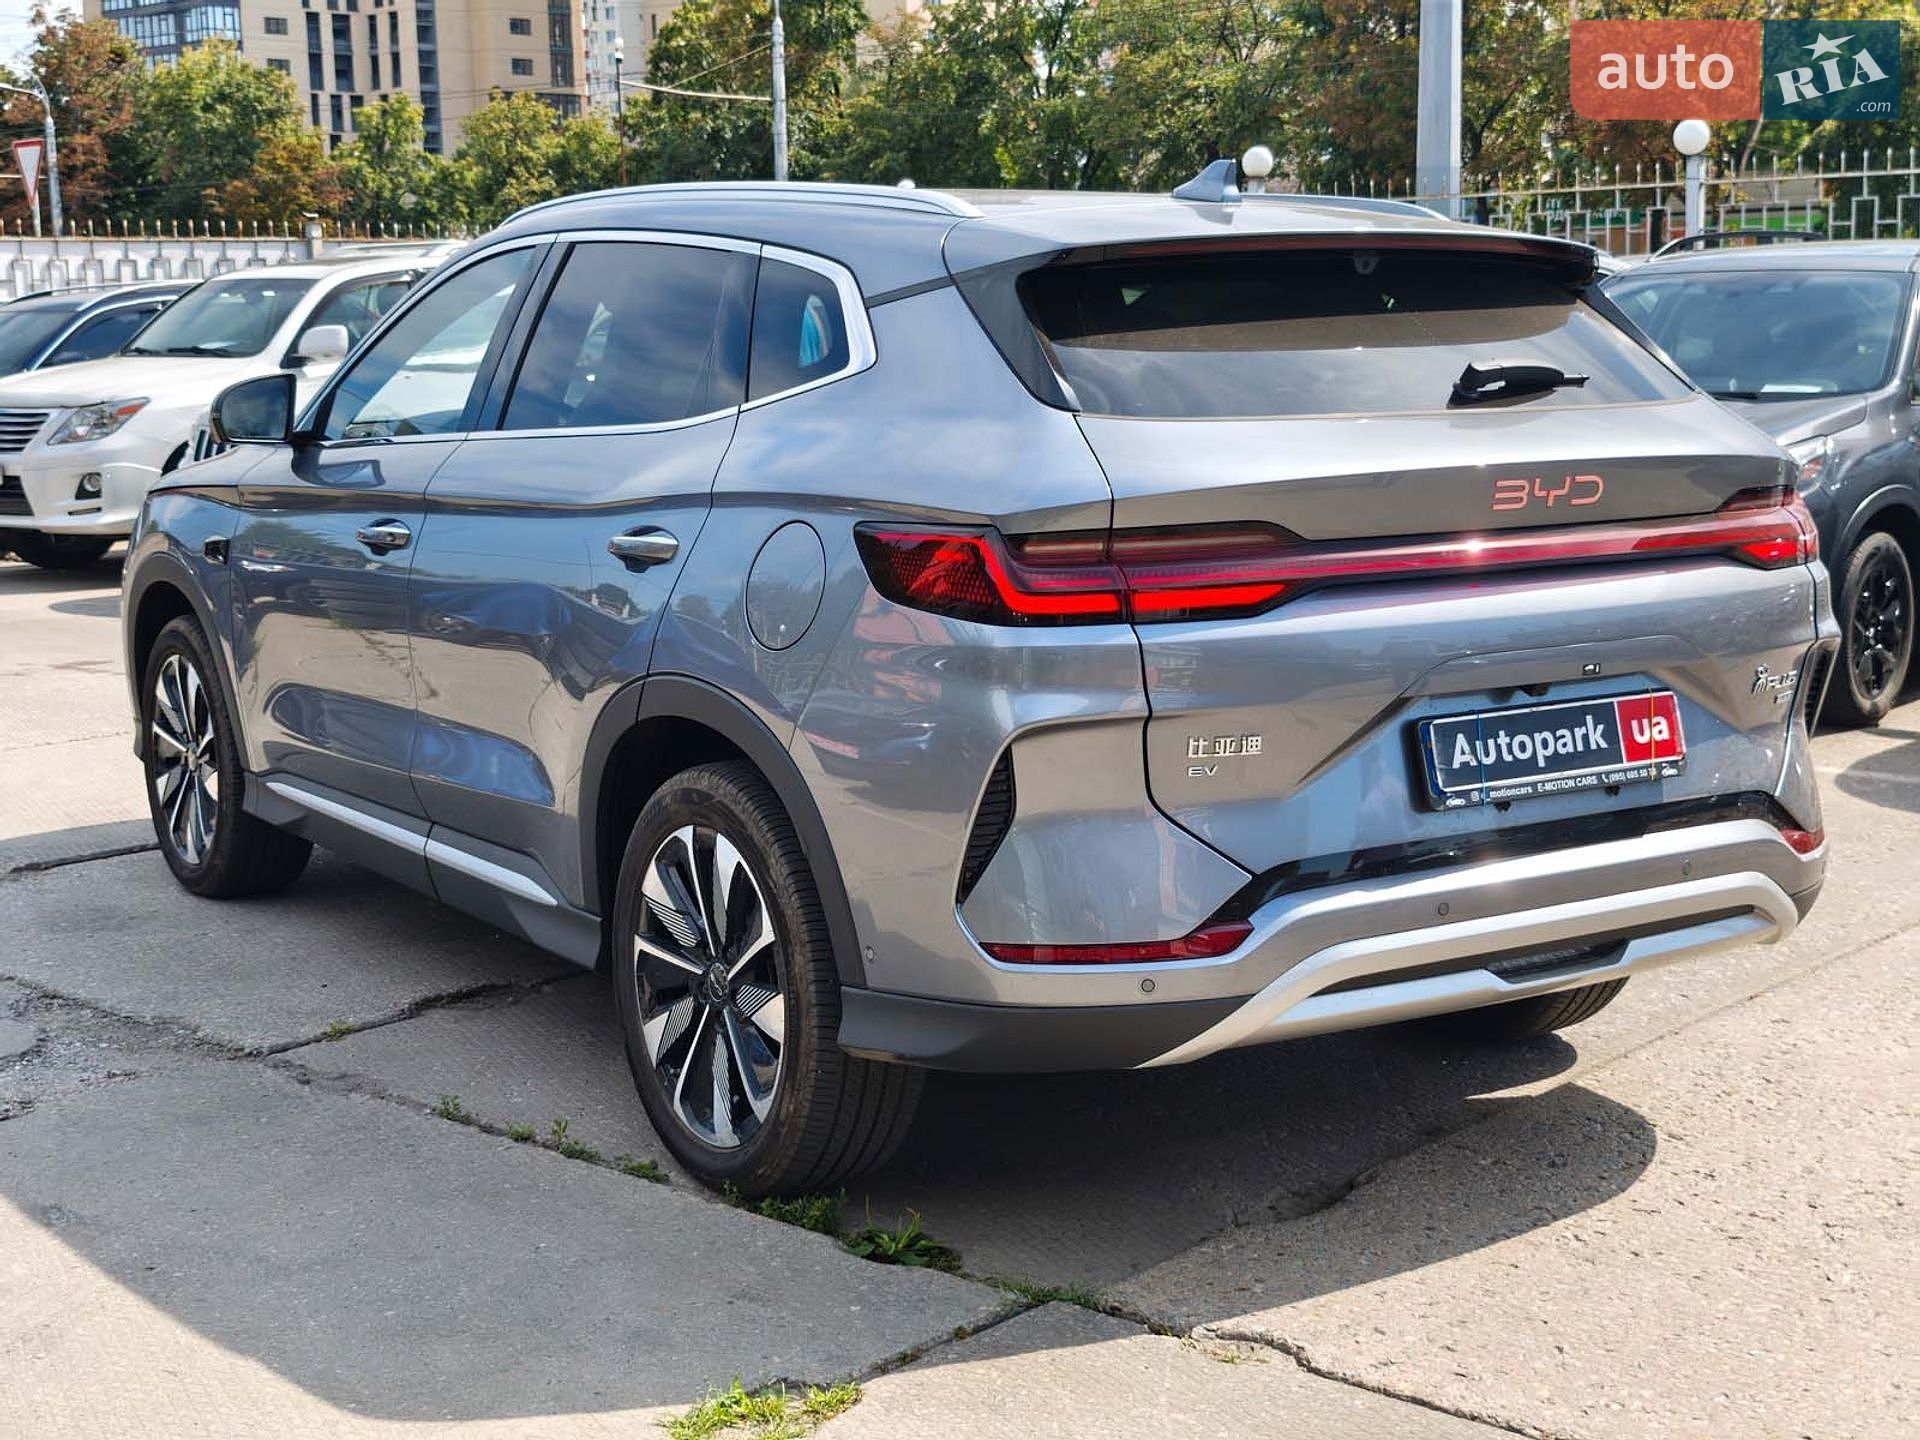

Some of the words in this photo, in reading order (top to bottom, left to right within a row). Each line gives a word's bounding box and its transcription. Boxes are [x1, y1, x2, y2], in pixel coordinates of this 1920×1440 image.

[1492, 475, 1604, 511] BYD
[1187, 735, 1262, 758] 比亚迪
[1451, 714, 1608, 769] Autopark
[1630, 714, 1670, 744] ua
[1188, 765, 1218, 777] EV
[1575, 775, 1598, 787] CARS
